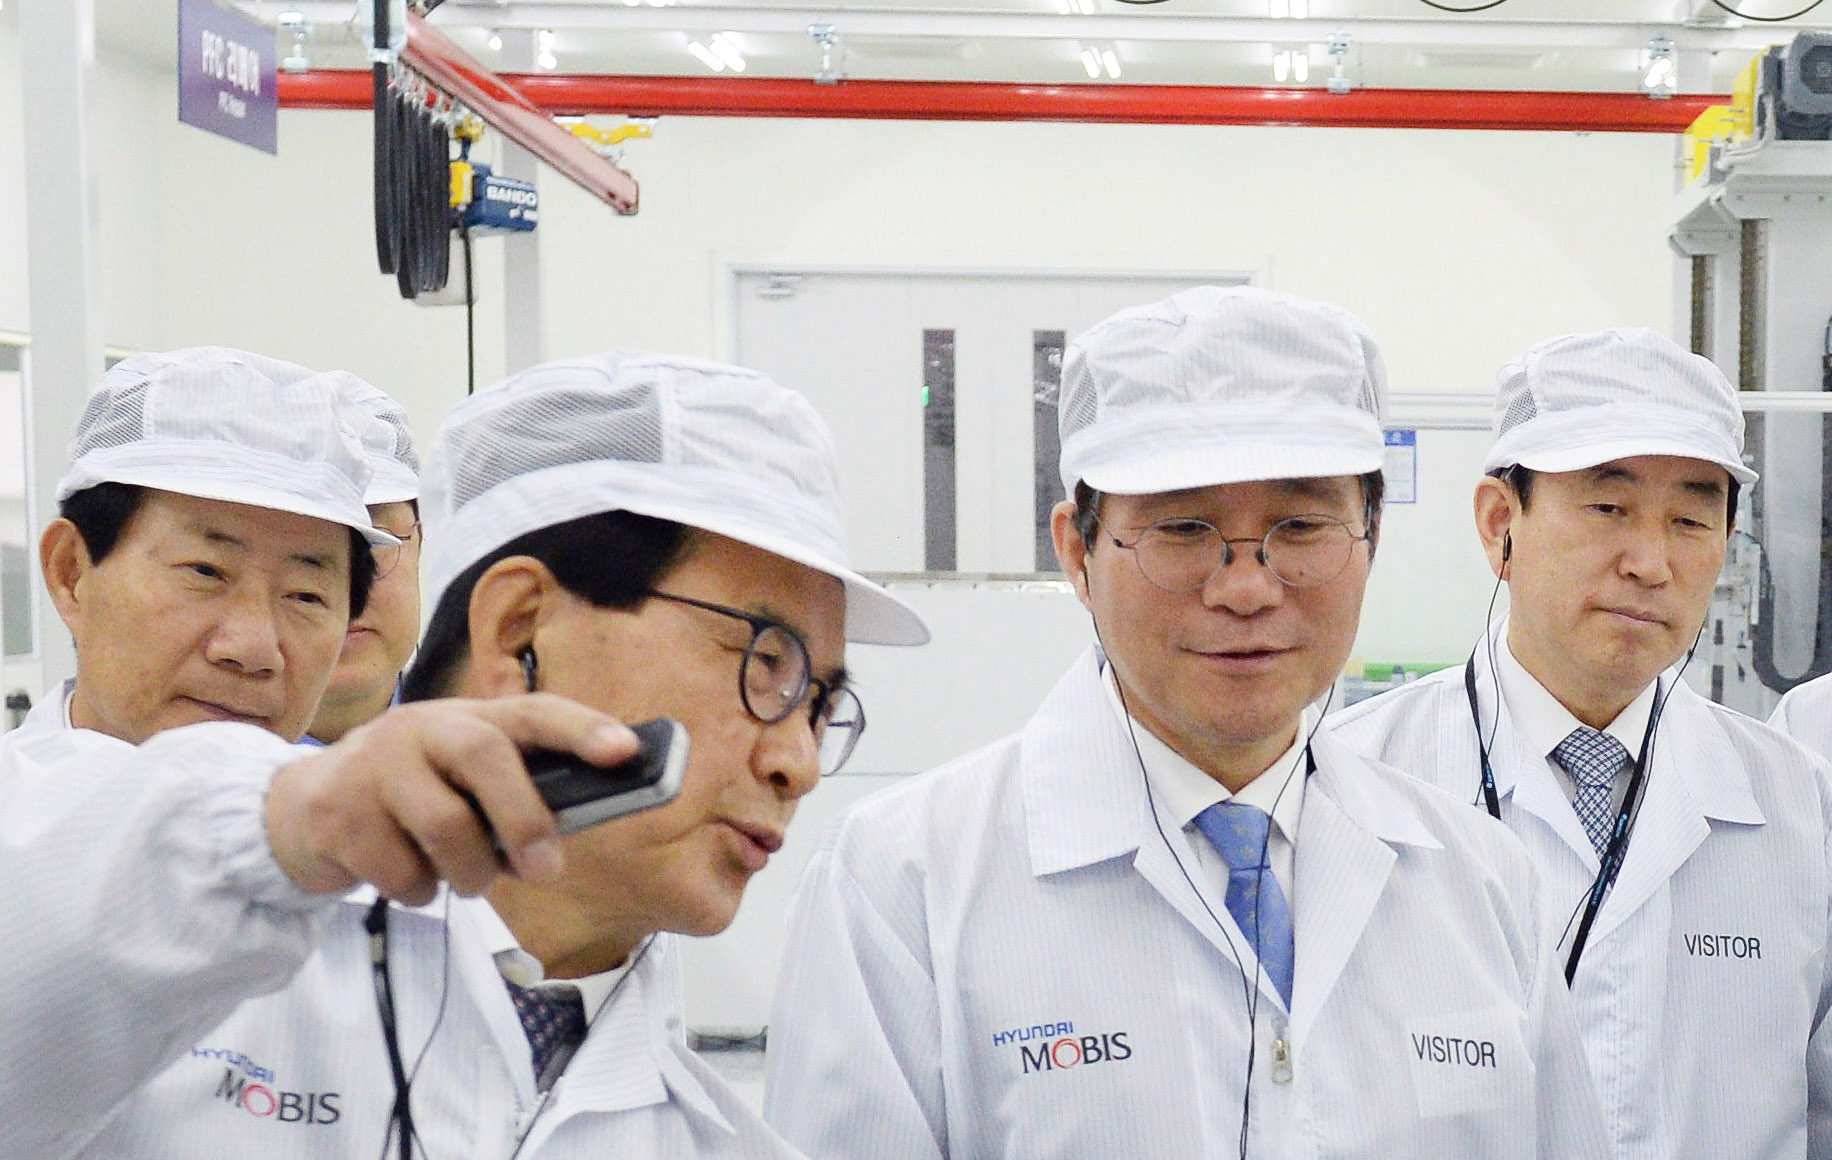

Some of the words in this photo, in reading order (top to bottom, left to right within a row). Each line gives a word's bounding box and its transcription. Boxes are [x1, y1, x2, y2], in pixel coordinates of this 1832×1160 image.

[1684, 933, 1761, 959] VISITOR
[992, 1021, 1075, 1046] HYUNDAI
[1411, 1032, 1496, 1068] VISITOR
[1020, 1032, 1132, 1074] MOBIS
[215, 1066, 341, 1125] MOBIS
